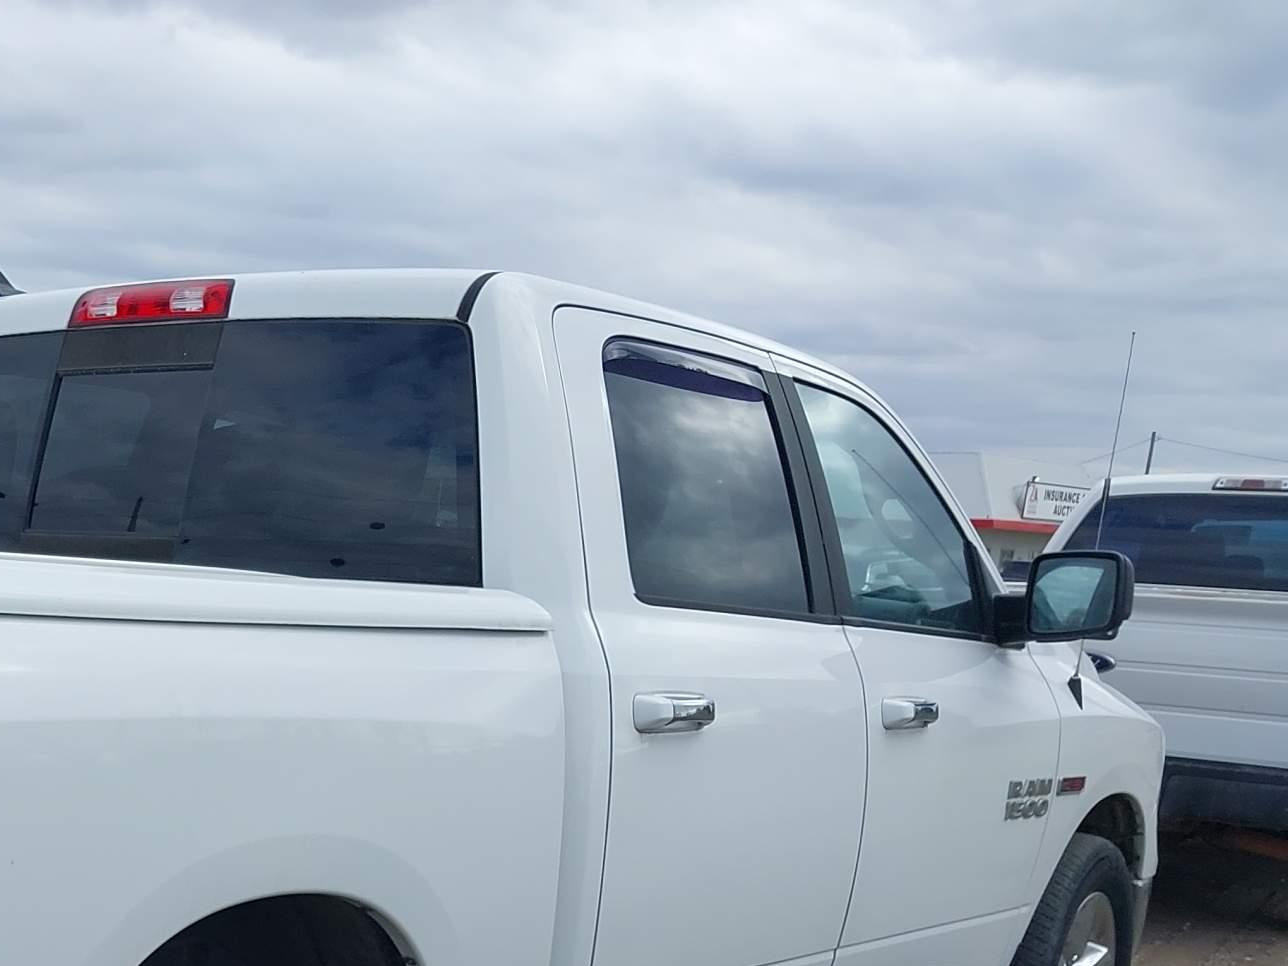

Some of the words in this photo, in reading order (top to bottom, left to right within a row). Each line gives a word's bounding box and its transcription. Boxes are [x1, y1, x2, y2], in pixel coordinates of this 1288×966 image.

[1043, 489, 1081, 504] INSURANCE
[1008, 779, 1053, 799] RAM
[1004, 800, 1049, 821] 1500
